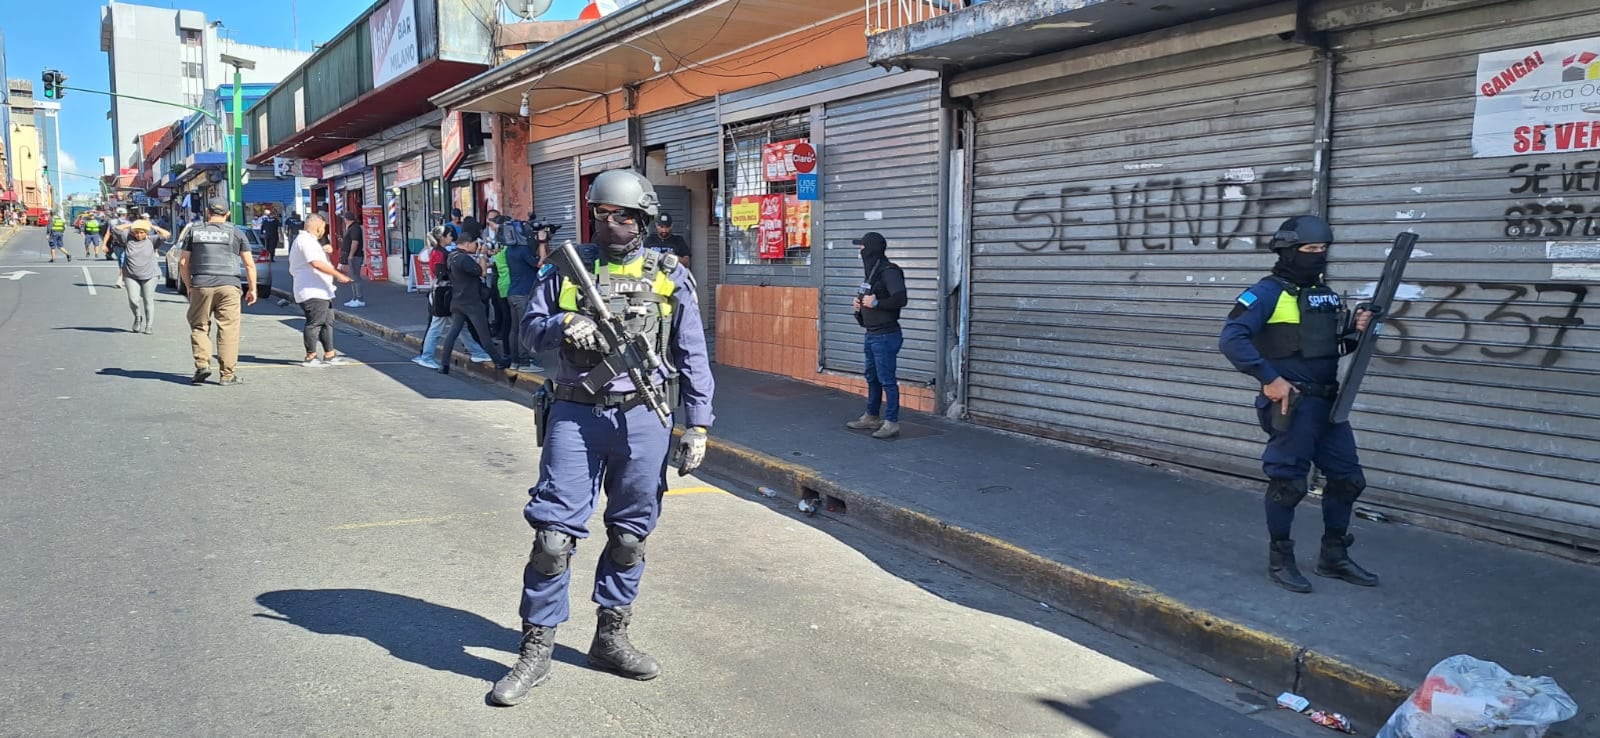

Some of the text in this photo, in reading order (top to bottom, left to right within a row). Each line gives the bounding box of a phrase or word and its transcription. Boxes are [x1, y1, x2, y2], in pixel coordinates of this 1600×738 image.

[397, 16, 411, 40] BAR
[390, 44, 415, 73] MILANO
[1481, 50, 1544, 97] GANGA!
[1529, 89, 1574, 102] Zona
[1513, 125, 1547, 153] SE
[792, 153, 813, 163] Claro
[1509, 163, 1551, 194] SE
[1013, 170, 1312, 251] SE VENDE
